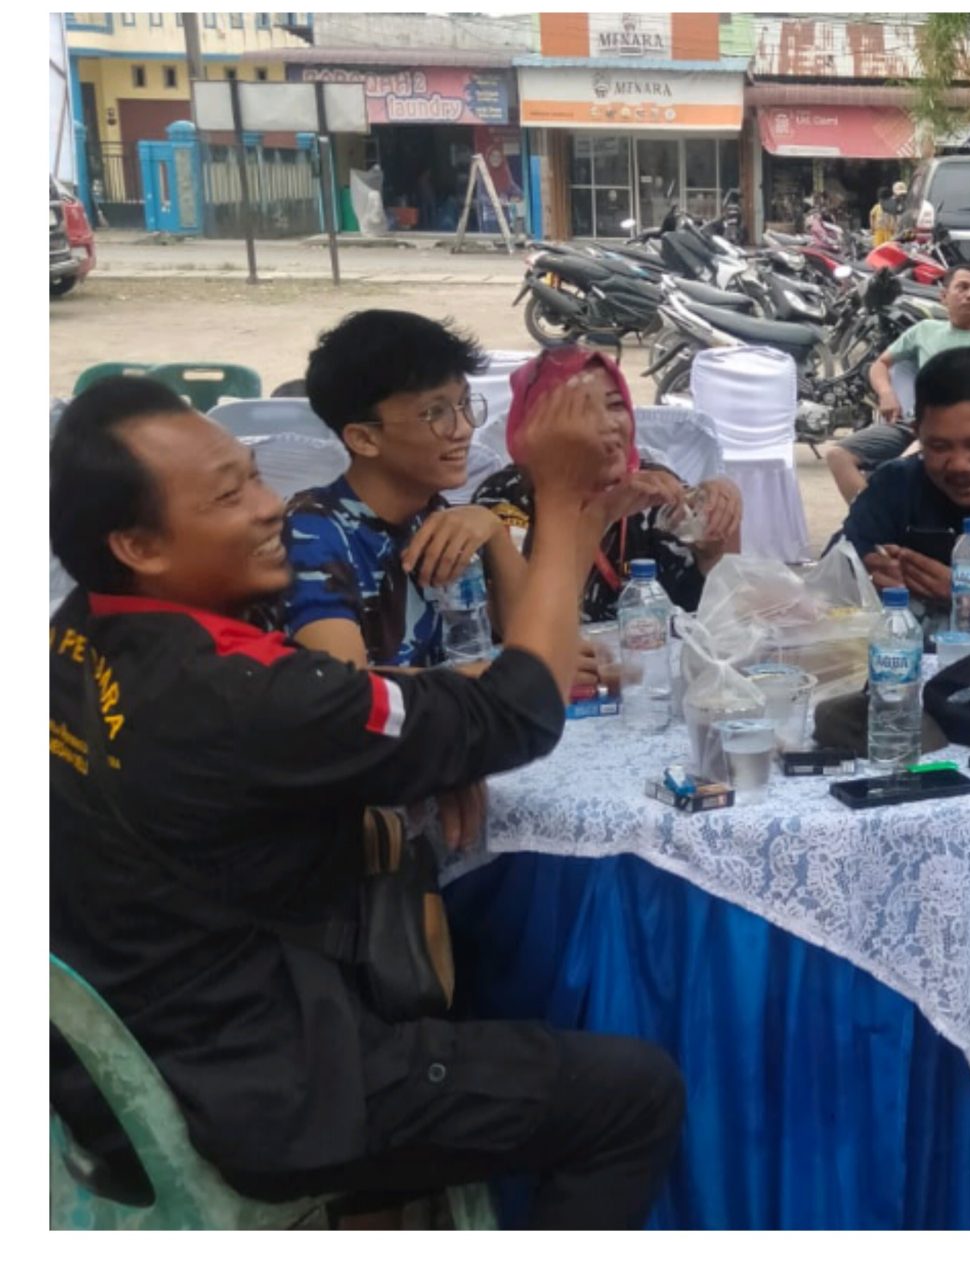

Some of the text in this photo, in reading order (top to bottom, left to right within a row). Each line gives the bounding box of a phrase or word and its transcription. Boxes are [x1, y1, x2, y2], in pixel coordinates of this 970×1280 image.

[599, 31, 665, 49] MENARA
[613, 80, 673, 98] MENARA
[389, 93, 462, 121] laundry
